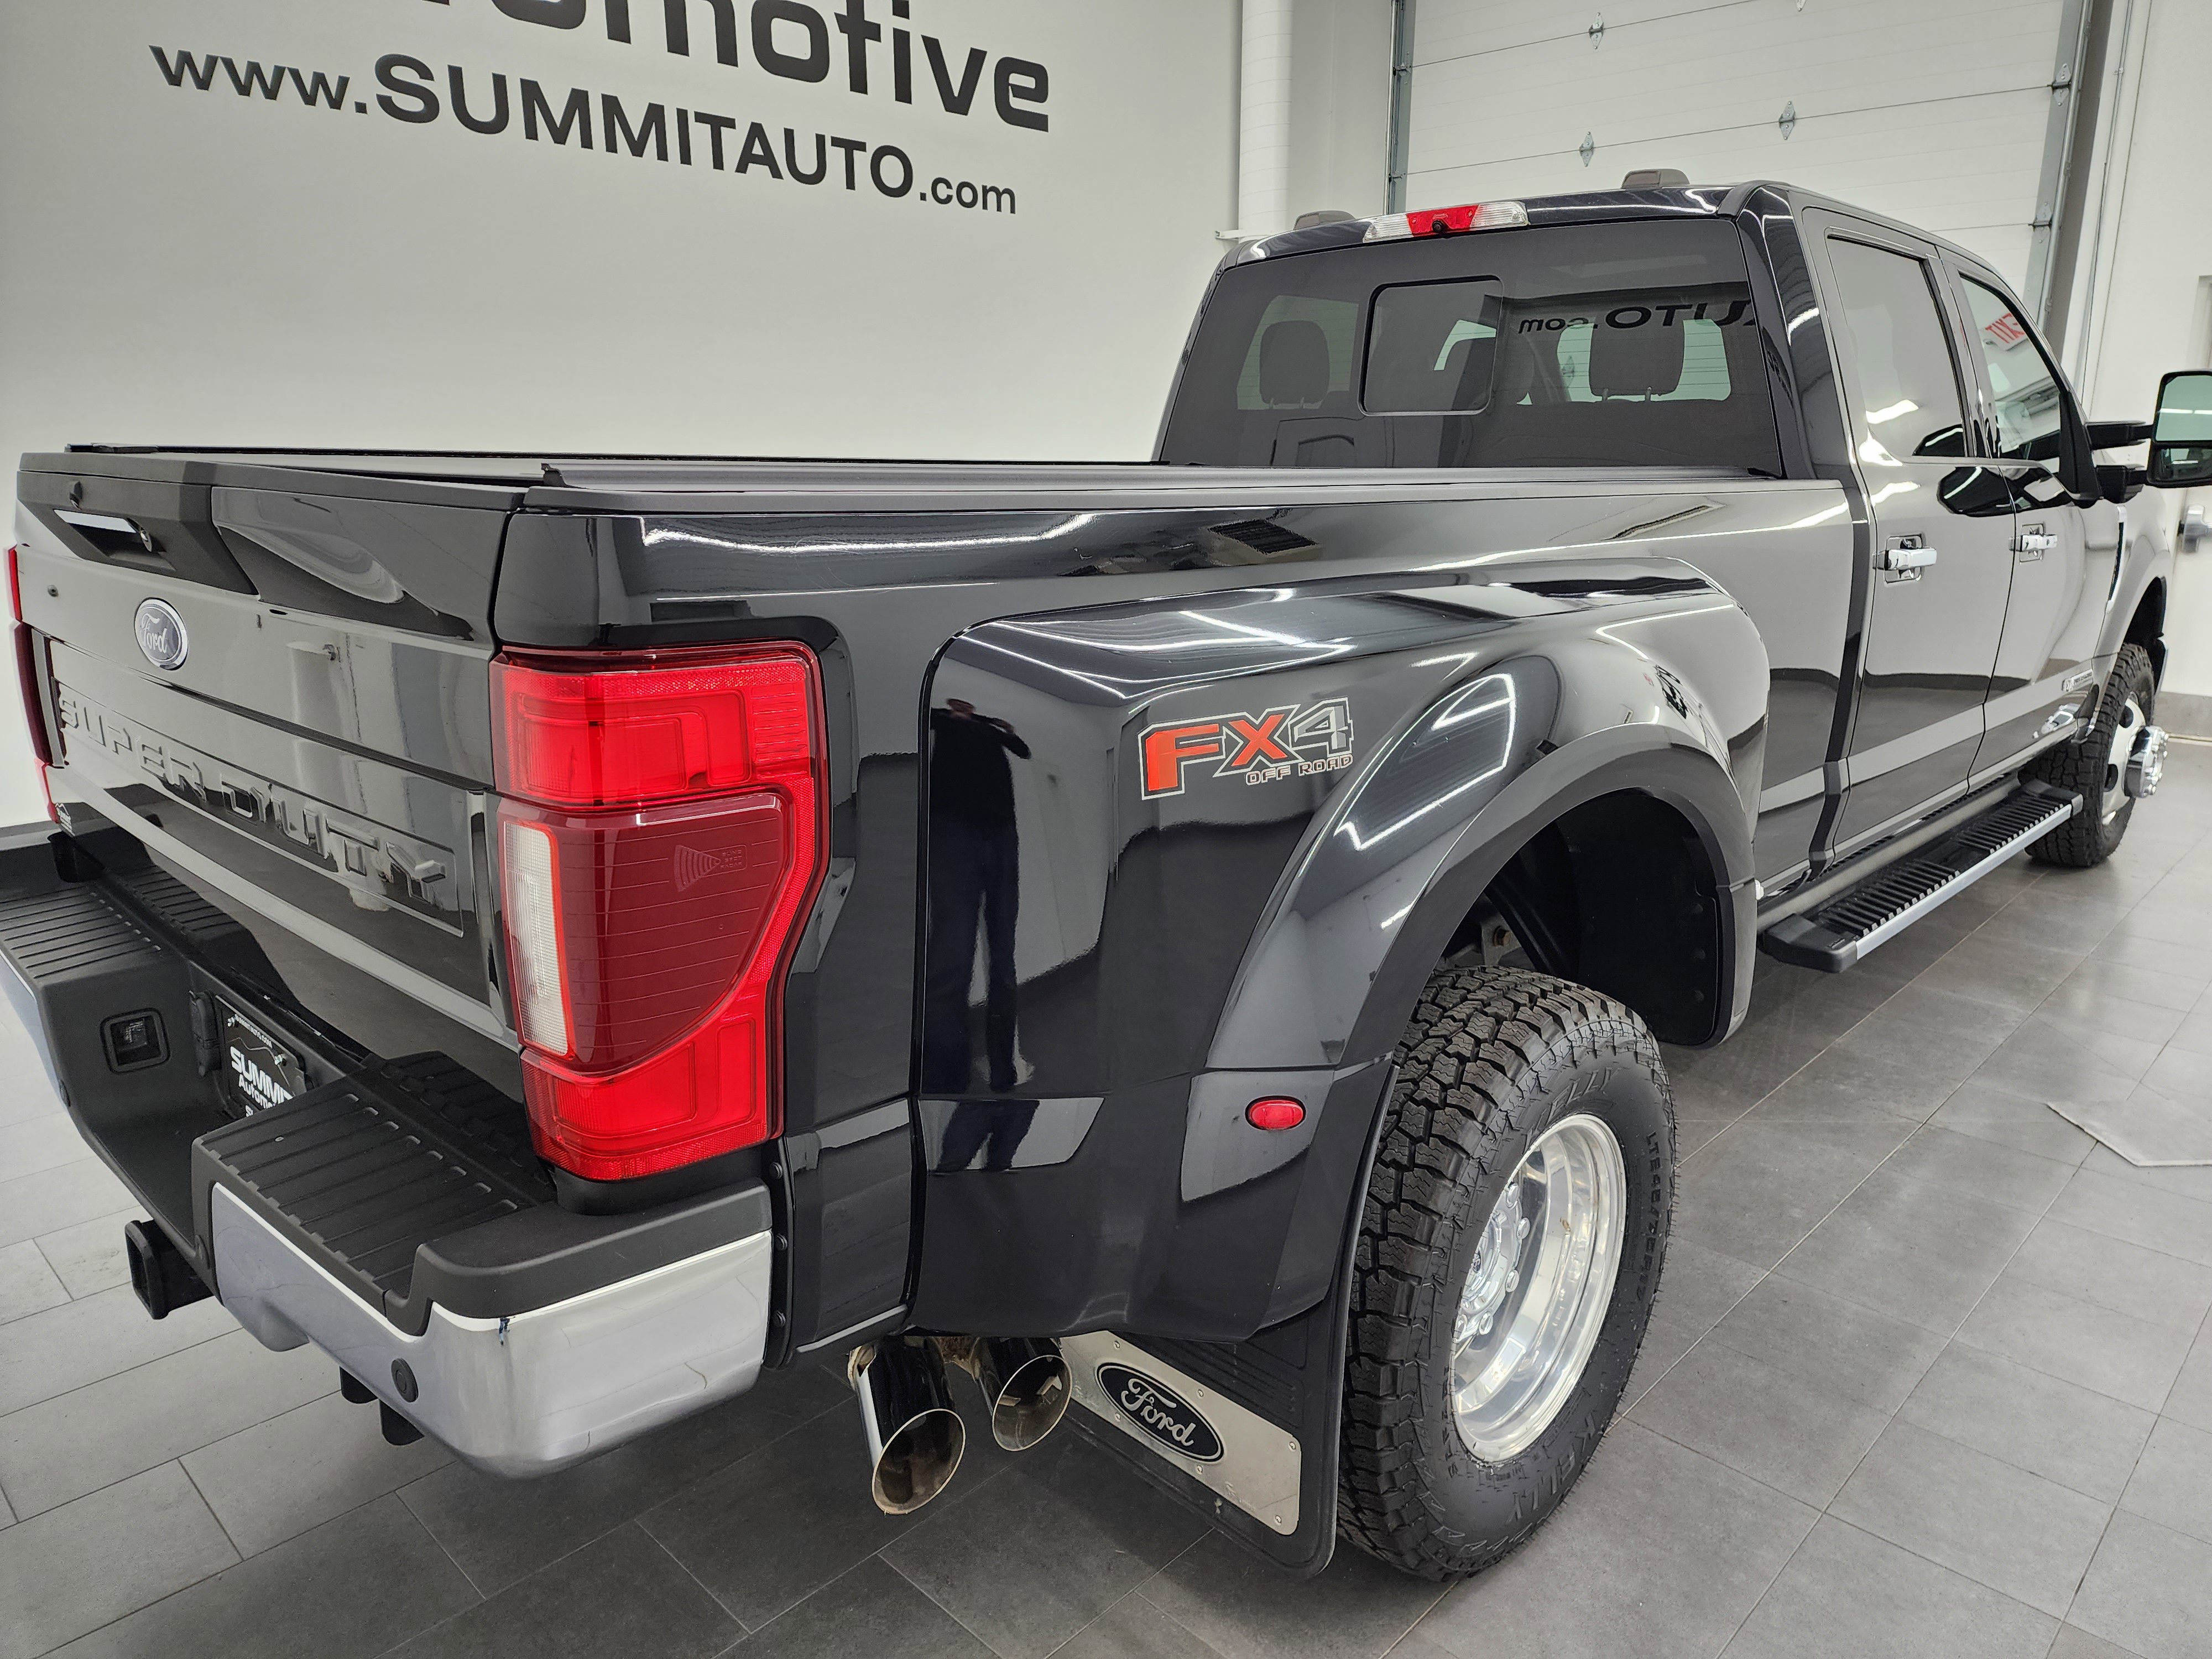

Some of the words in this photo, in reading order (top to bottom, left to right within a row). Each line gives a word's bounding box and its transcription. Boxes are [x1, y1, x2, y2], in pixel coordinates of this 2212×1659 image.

[422, 0, 1048, 132] motive
[148, 44, 1016, 214] www.SUMMITAUTO.com
[140, 613, 168, 654] Ford
[59, 693, 207, 803] SUPER
[221, 775, 447, 905] DUTY
[1138, 697, 1354, 800] FX4
[1245, 765, 1292, 785] OFF
[1298, 754, 1353, 776] ROAD
[1121, 1378, 1195, 1447] Ford
